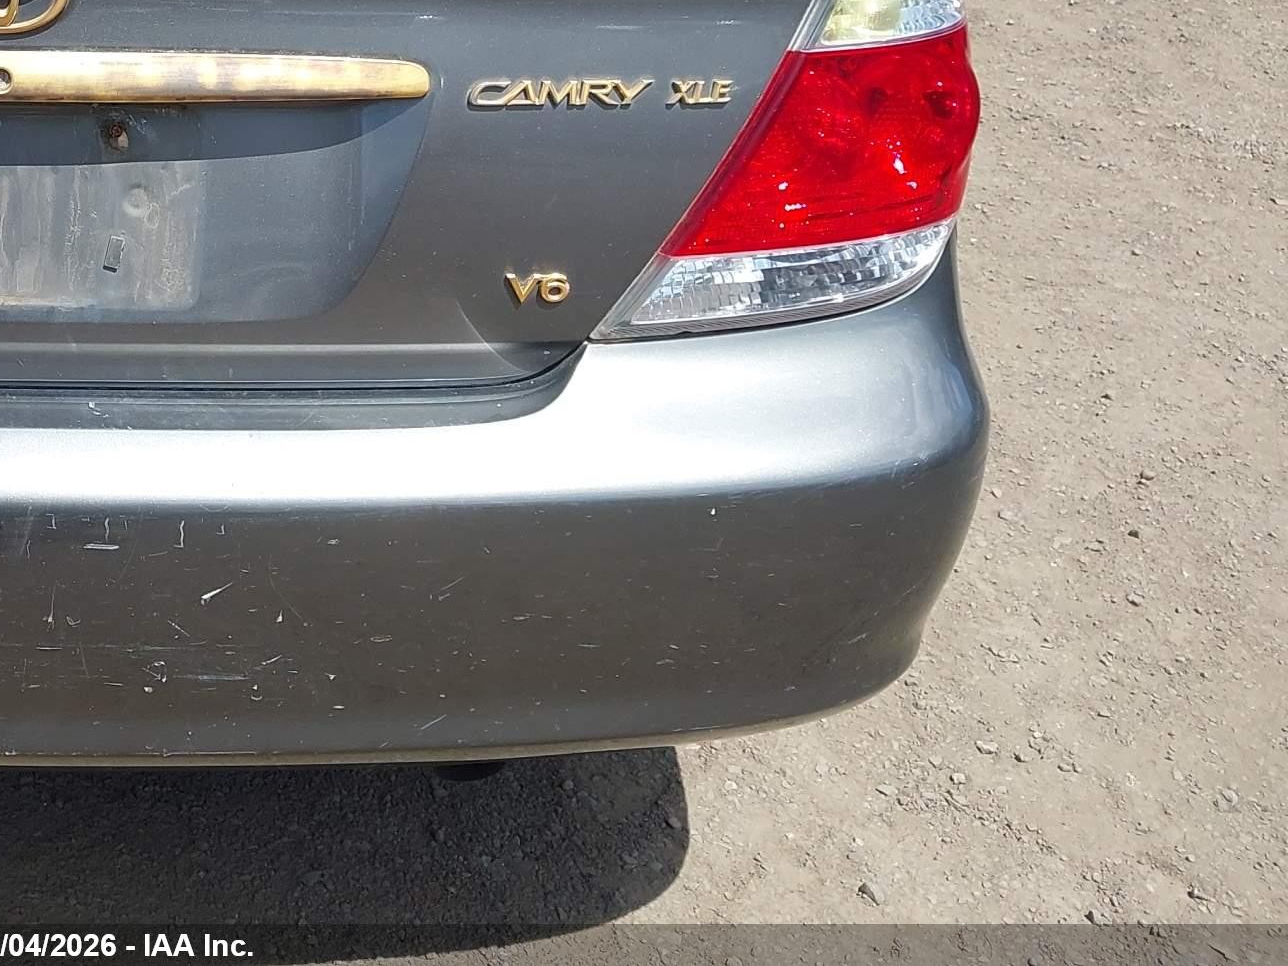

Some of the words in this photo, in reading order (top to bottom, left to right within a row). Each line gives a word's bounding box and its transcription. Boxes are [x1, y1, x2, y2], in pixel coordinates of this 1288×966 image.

[467, 79, 655, 109] CAMRY
[665, 79, 735, 107] XLE
[504, 273, 570, 304] V6
